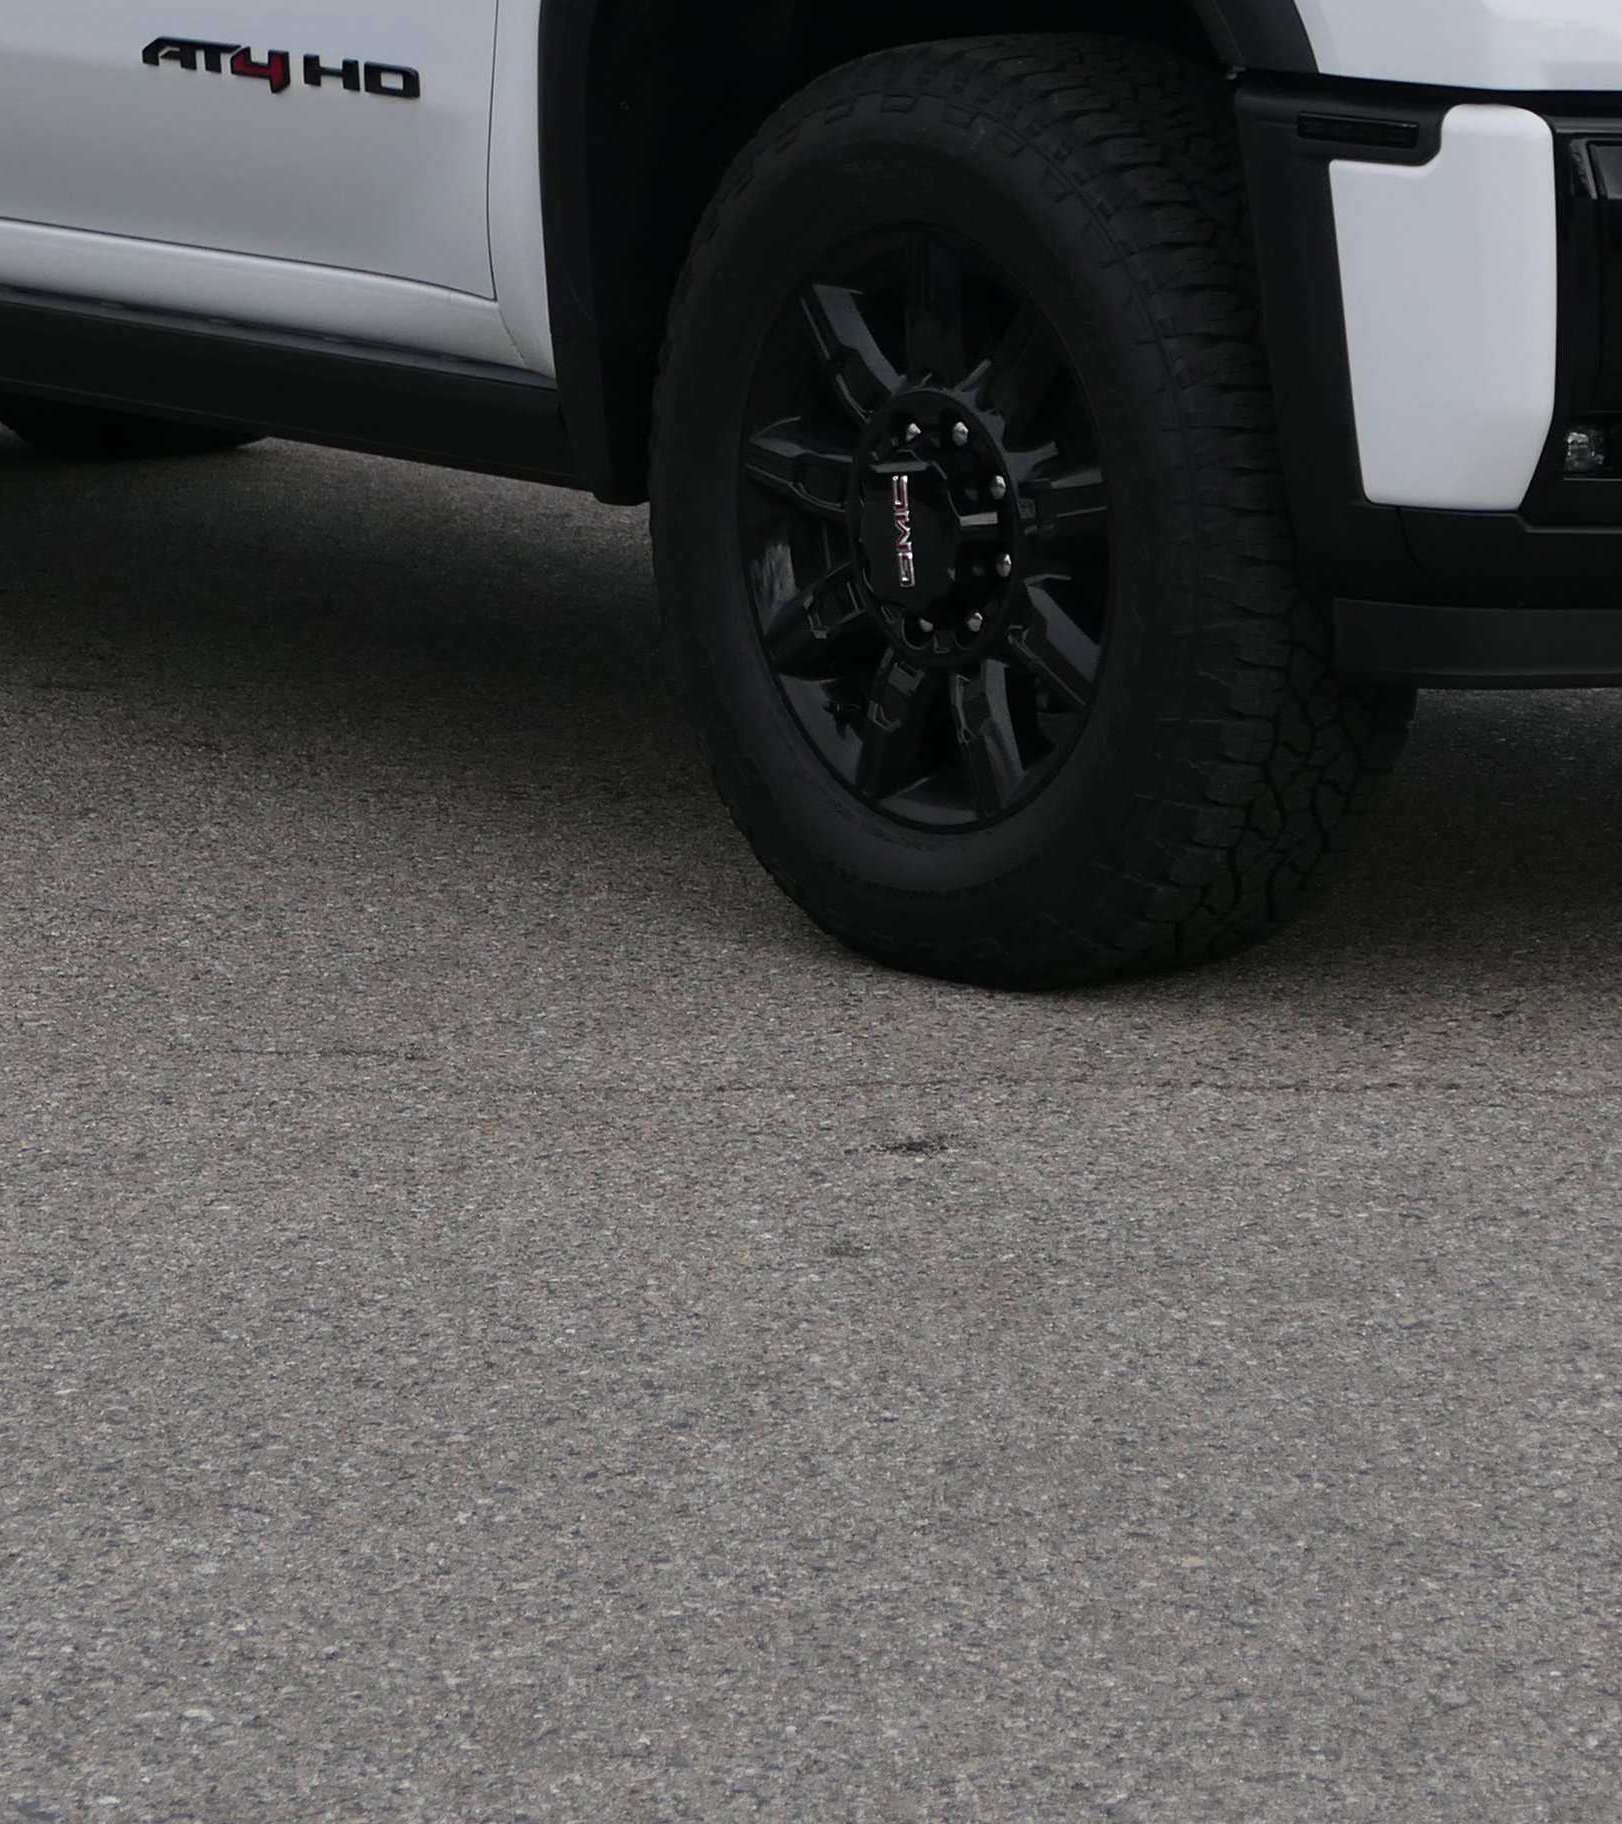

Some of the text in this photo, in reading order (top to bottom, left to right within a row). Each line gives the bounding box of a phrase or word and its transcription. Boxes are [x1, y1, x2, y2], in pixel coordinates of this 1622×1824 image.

[141, 36, 421, 98] AT4 HD
[890, 473, 918, 588] GMC
